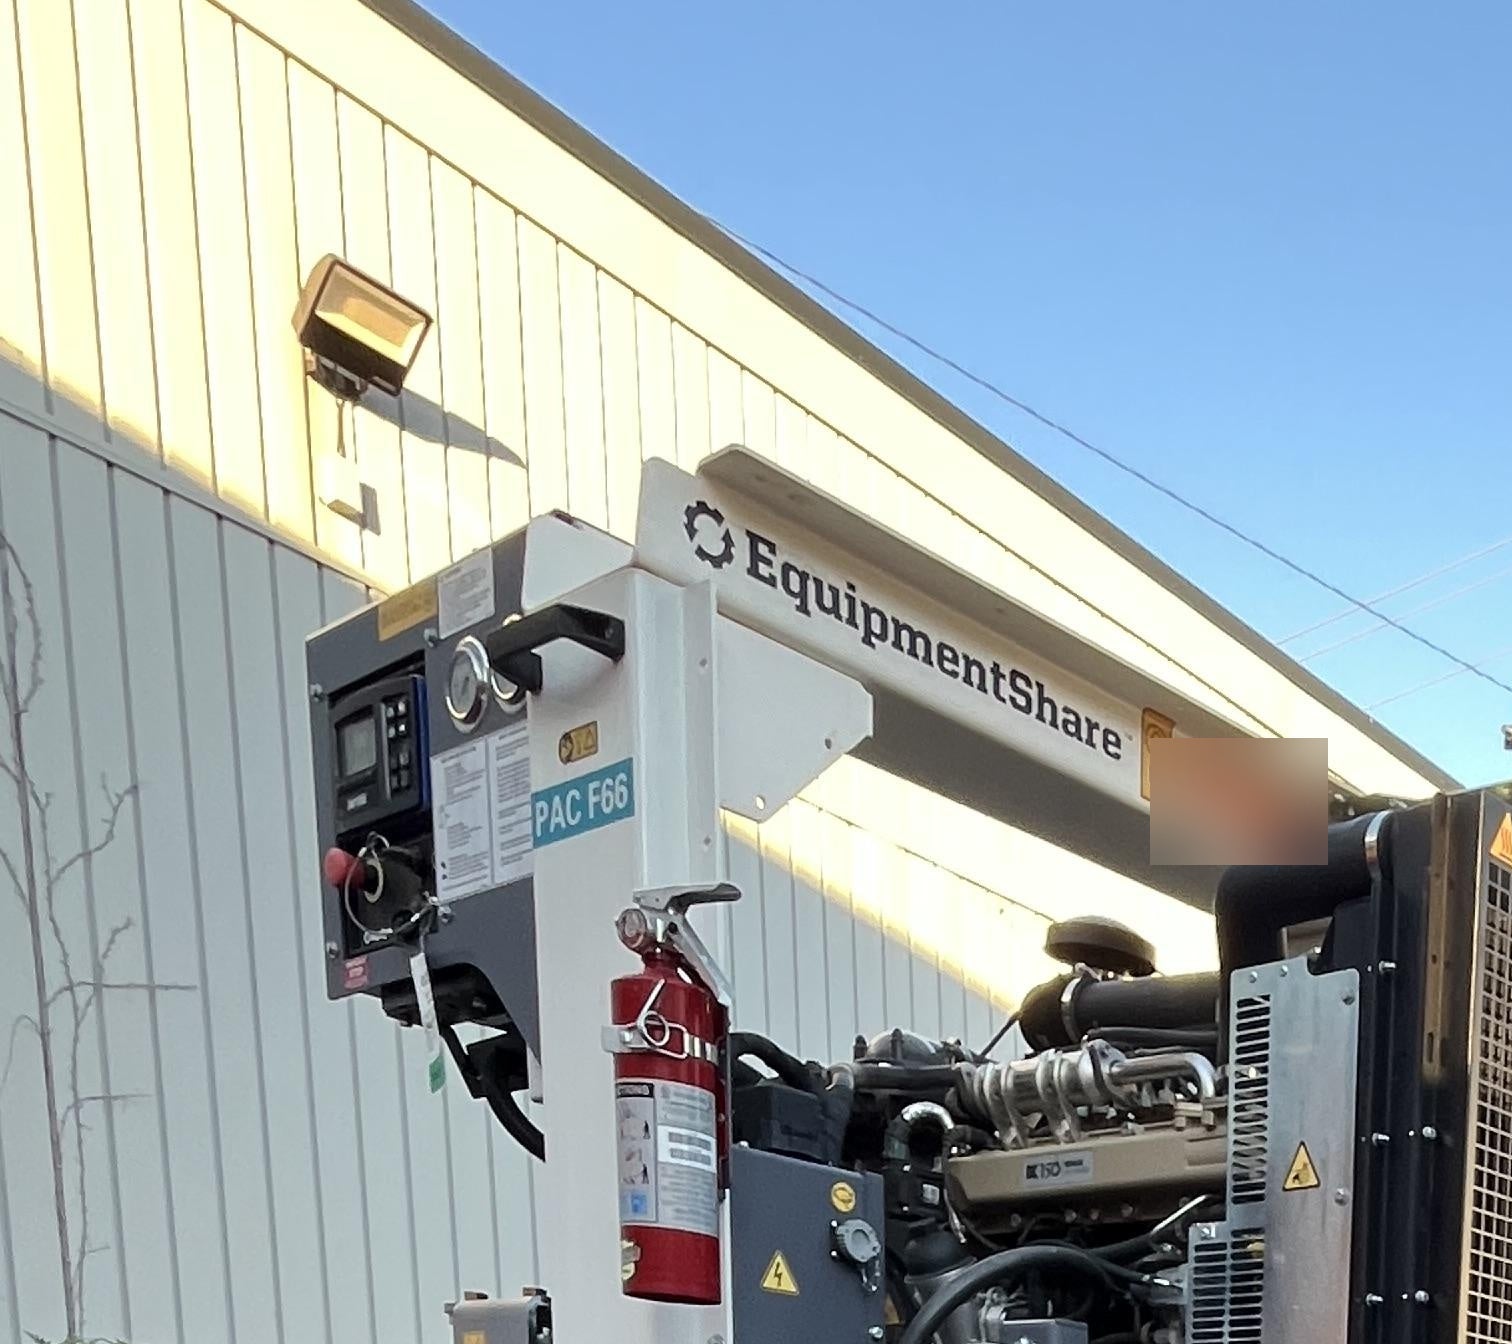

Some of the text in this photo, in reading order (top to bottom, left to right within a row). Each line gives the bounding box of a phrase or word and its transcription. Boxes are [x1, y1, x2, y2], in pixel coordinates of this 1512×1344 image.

[745, 528, 1122, 761] EquipmentShare
[535, 772, 629, 838] PAC F66
